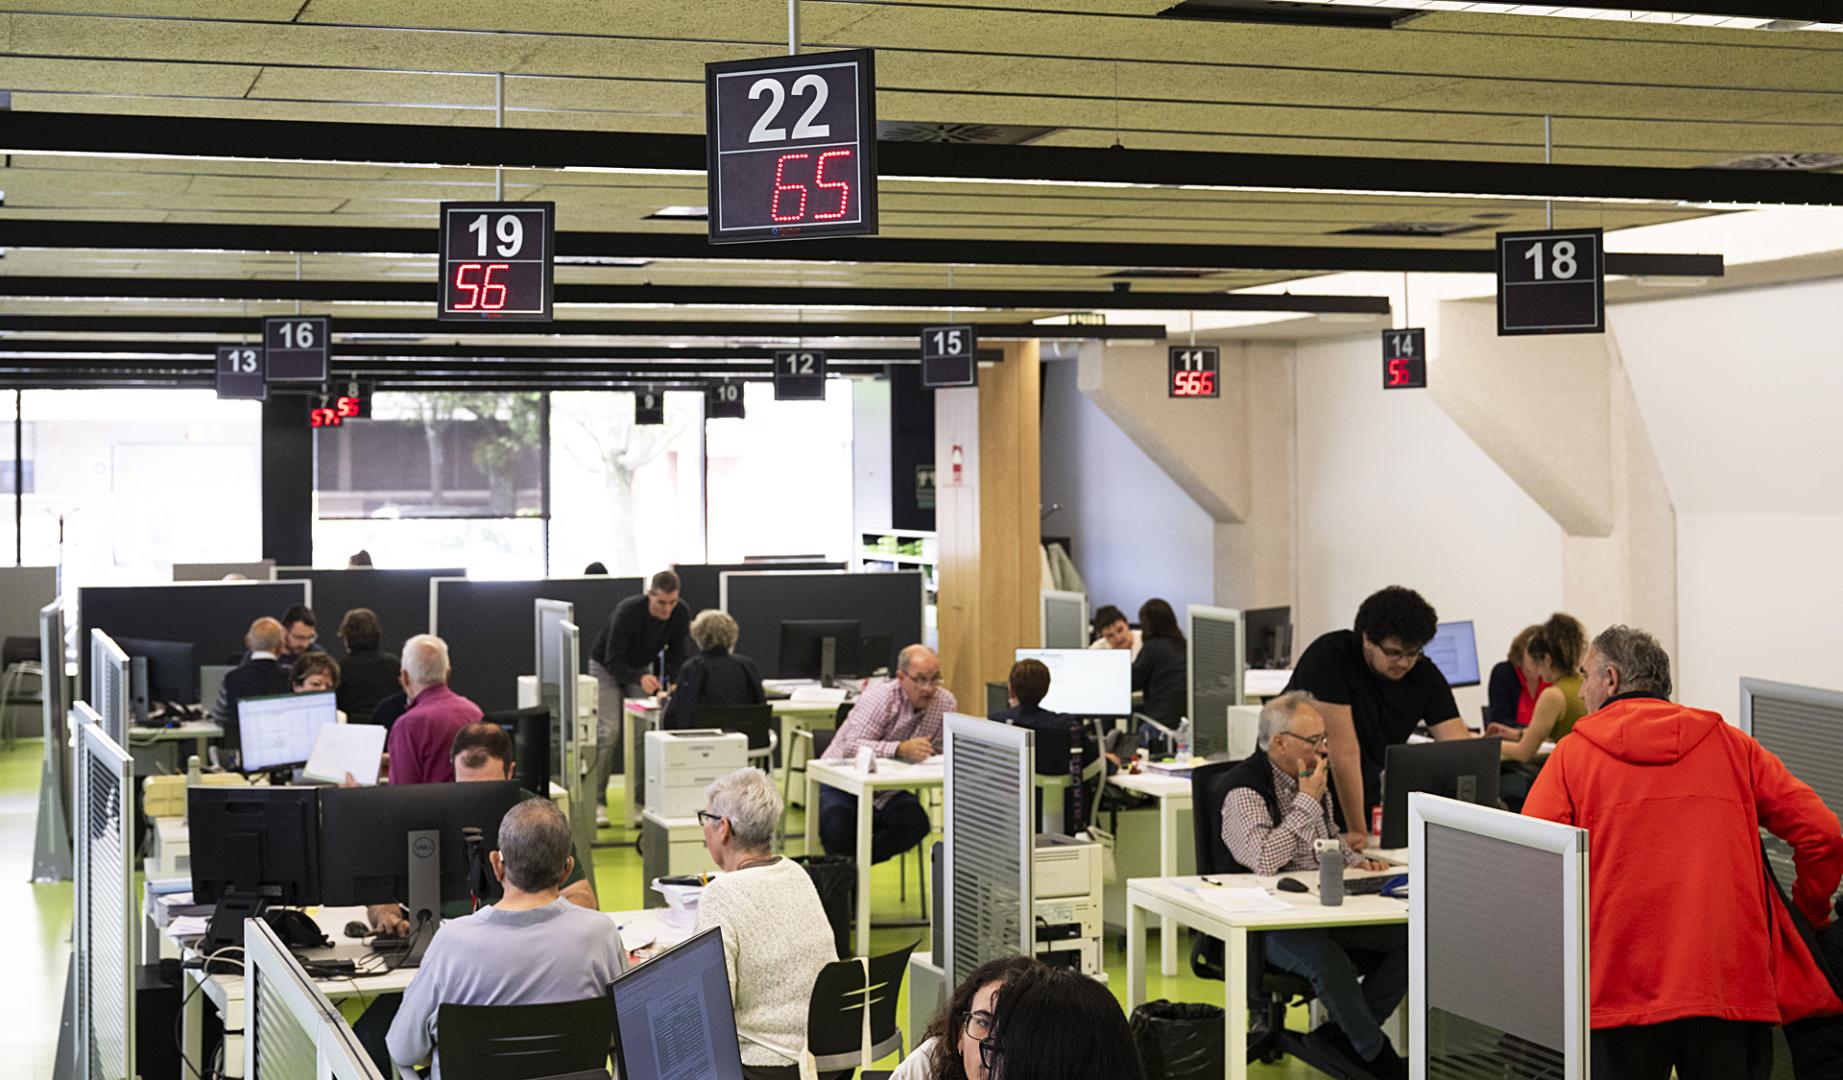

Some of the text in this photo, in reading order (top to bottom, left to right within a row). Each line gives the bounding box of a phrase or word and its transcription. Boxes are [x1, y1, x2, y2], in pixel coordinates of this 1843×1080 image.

[748, 74, 830, 143] 22
[771, 150, 850, 222] 65
[468, 214, 523, 258] 19
[1524, 241, 1577, 280] 18
[454, 264, 509, 309] 56
[279, 322, 314, 349] 16
[933, 330, 962, 356] 15
[1391, 334, 1414, 358] 14
[227, 349, 257, 373] 13
[786, 353, 814, 375] 12
[1180, 350, 1203, 372] 11
[717, 385, 738, 402] 10
[1173, 371, 1215, 396] 566
